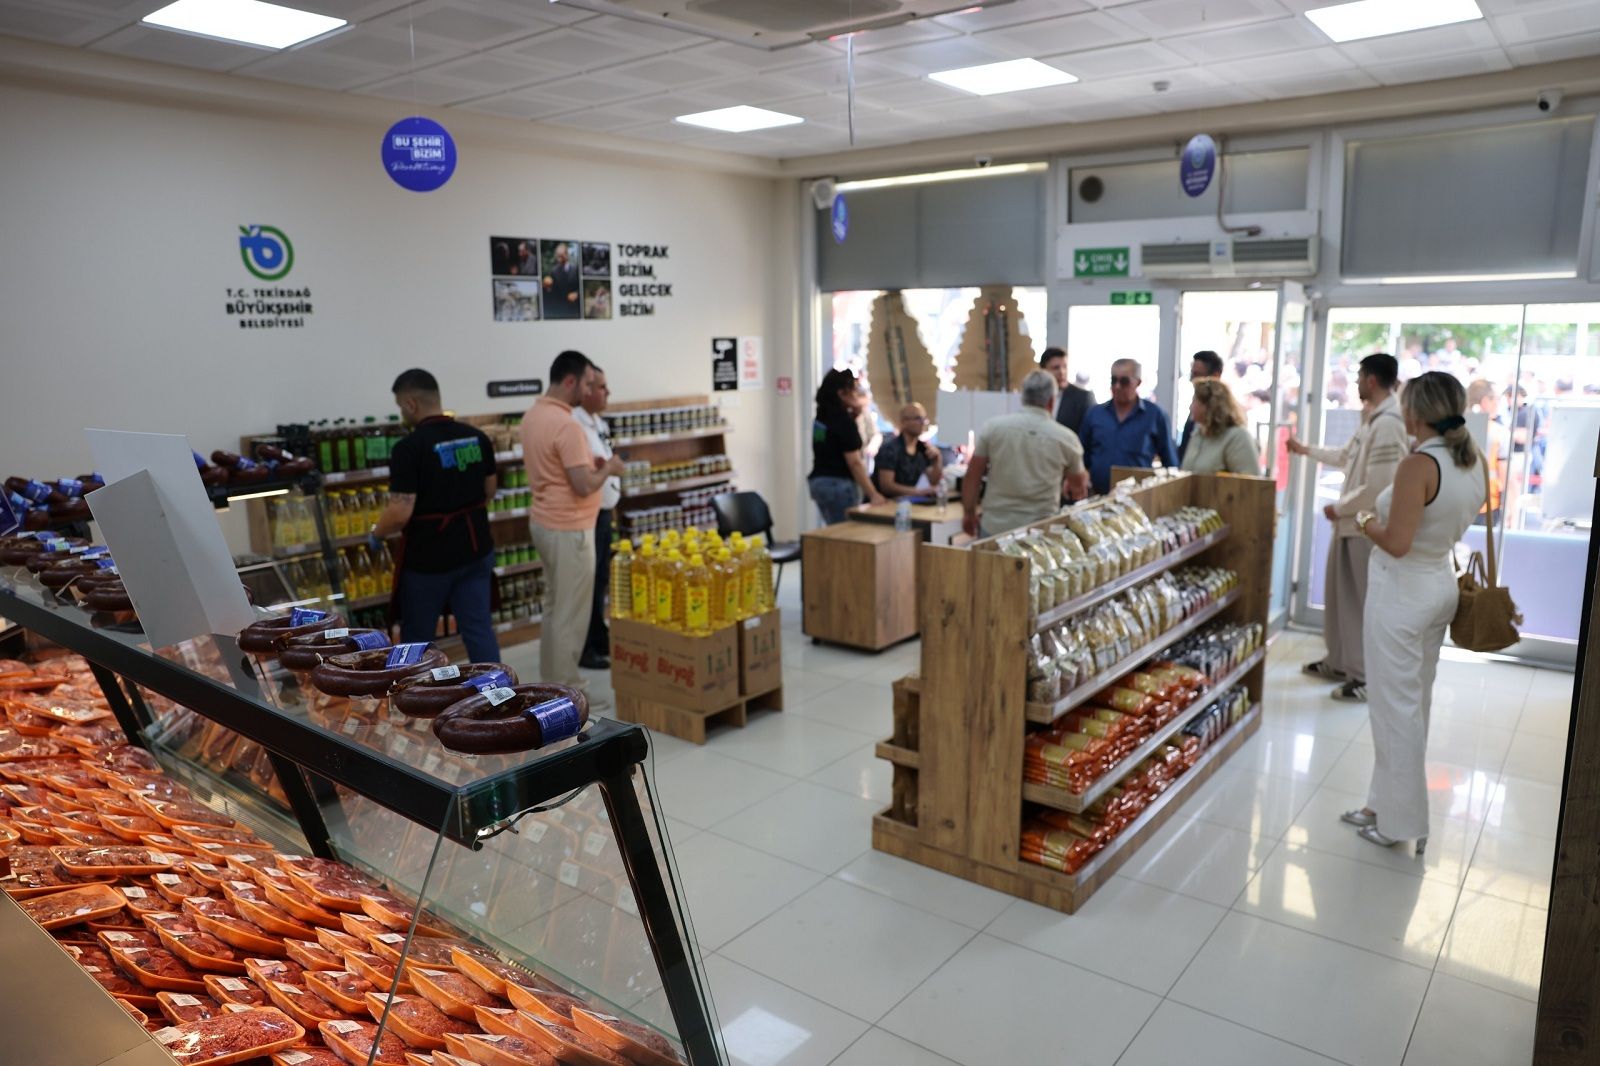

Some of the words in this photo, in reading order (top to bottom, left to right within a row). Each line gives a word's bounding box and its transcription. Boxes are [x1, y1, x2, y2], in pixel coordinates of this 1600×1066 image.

[395, 136, 410, 147] BU
[412, 135, 441, 149] ŞEHİR
[414, 148, 442, 159] BİZİM
[617, 244, 669, 258] TOPRAK
[618, 260, 657, 280] BİZİM,
[226, 288, 249, 298] T.C.
[253, 286, 311, 298] TEKİRDAĞ
[619, 284, 673, 297] GELECEK
[226, 299, 313, 316] BÜYÜKŞEHİR
[620, 300, 655, 317] BİZİM
[240, 316, 304, 329] BELEDİYESİ
